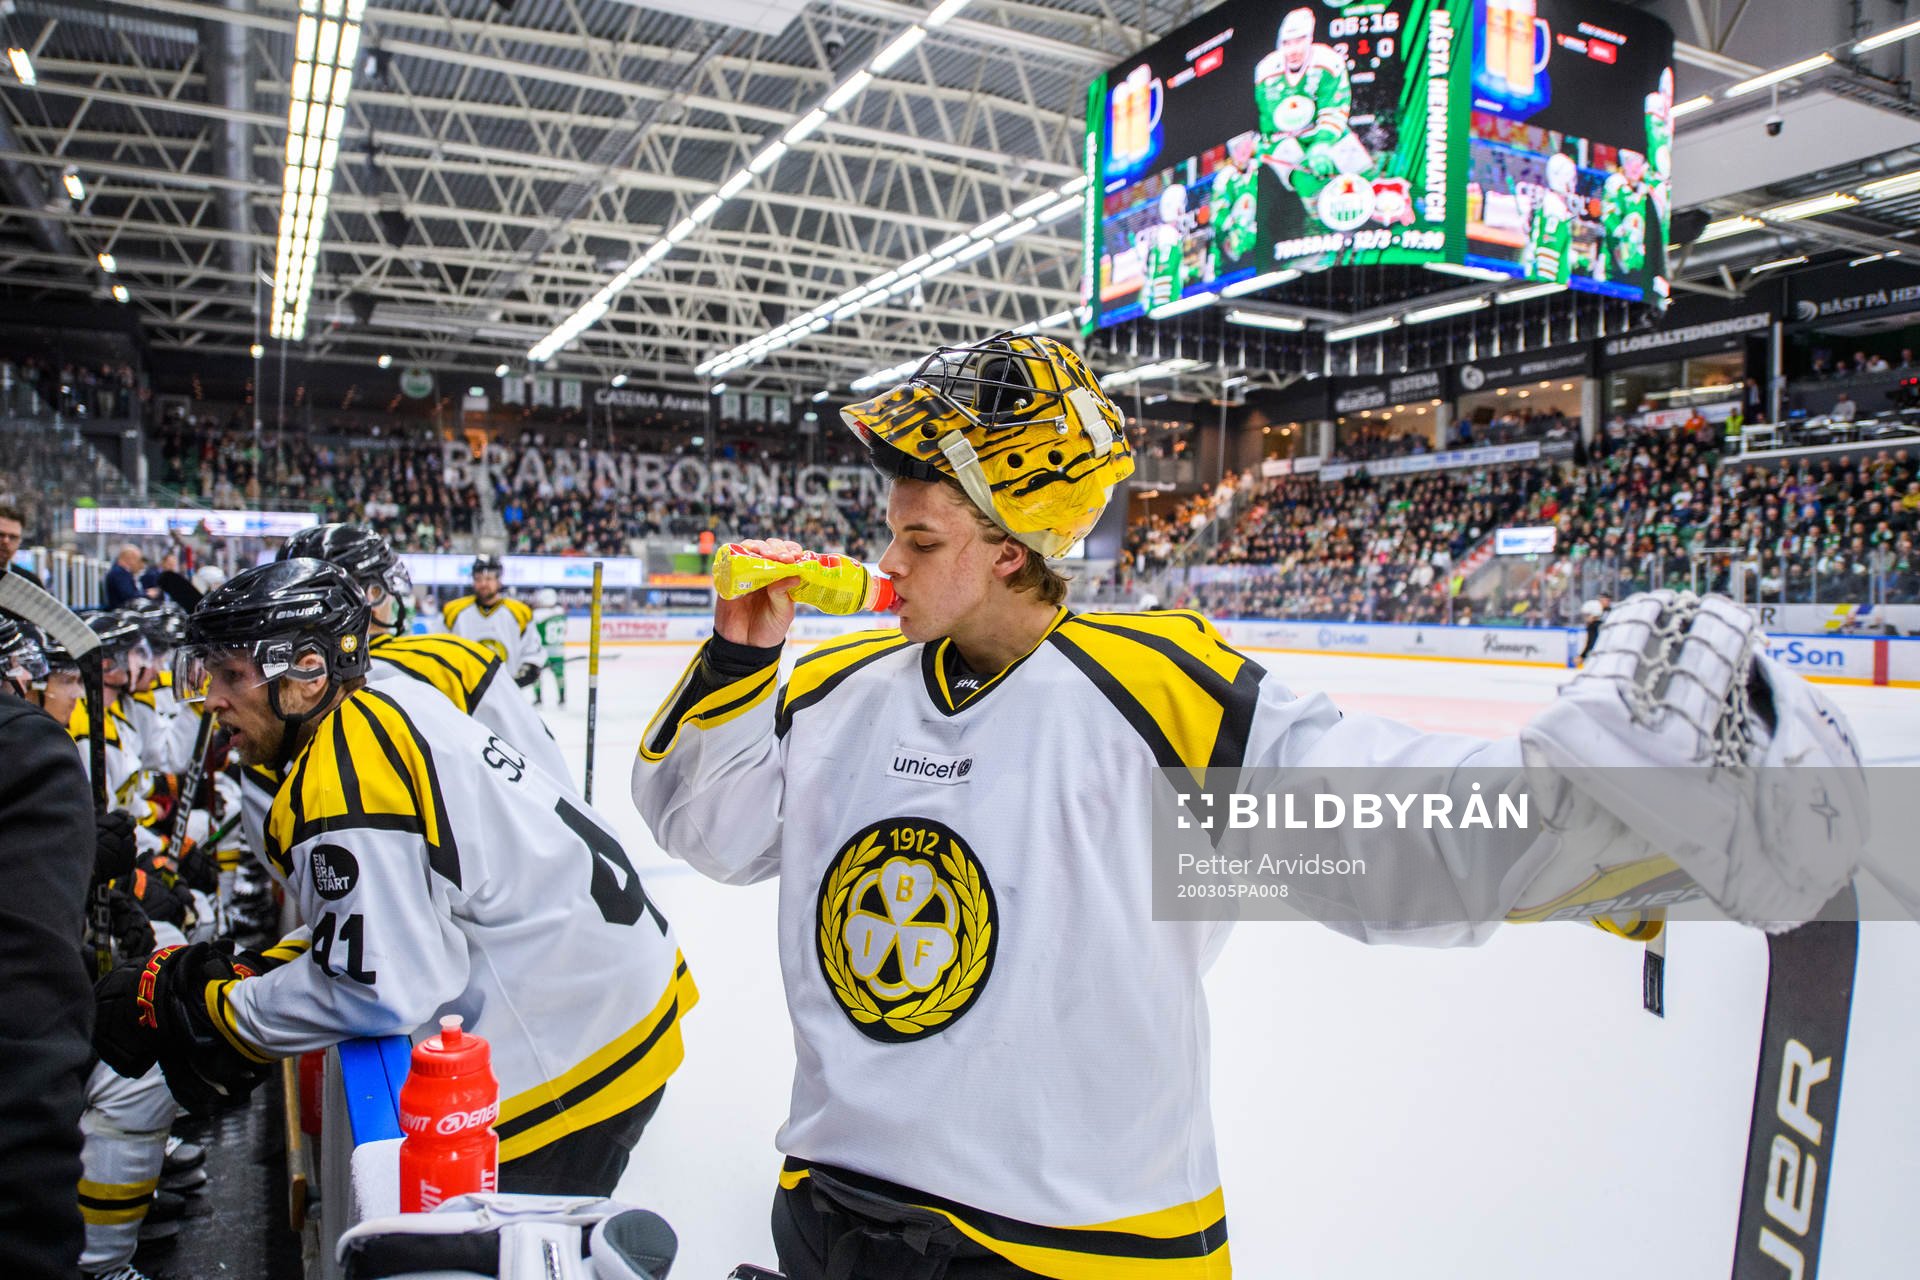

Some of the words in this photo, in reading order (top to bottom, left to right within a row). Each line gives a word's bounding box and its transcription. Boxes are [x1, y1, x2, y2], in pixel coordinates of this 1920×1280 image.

[595, 389, 659, 408] CATENA
[955, 680, 980, 690] SHL
[894, 757, 957, 779] unicef
[890, 828, 939, 856] 1912
[313, 854, 326, 866] EN
[315, 866, 336, 878] BRA
[317, 876, 350, 891] START
[896, 875, 914, 902] B
[312, 912, 377, 985] 41
[914, 939, 933, 967] F
